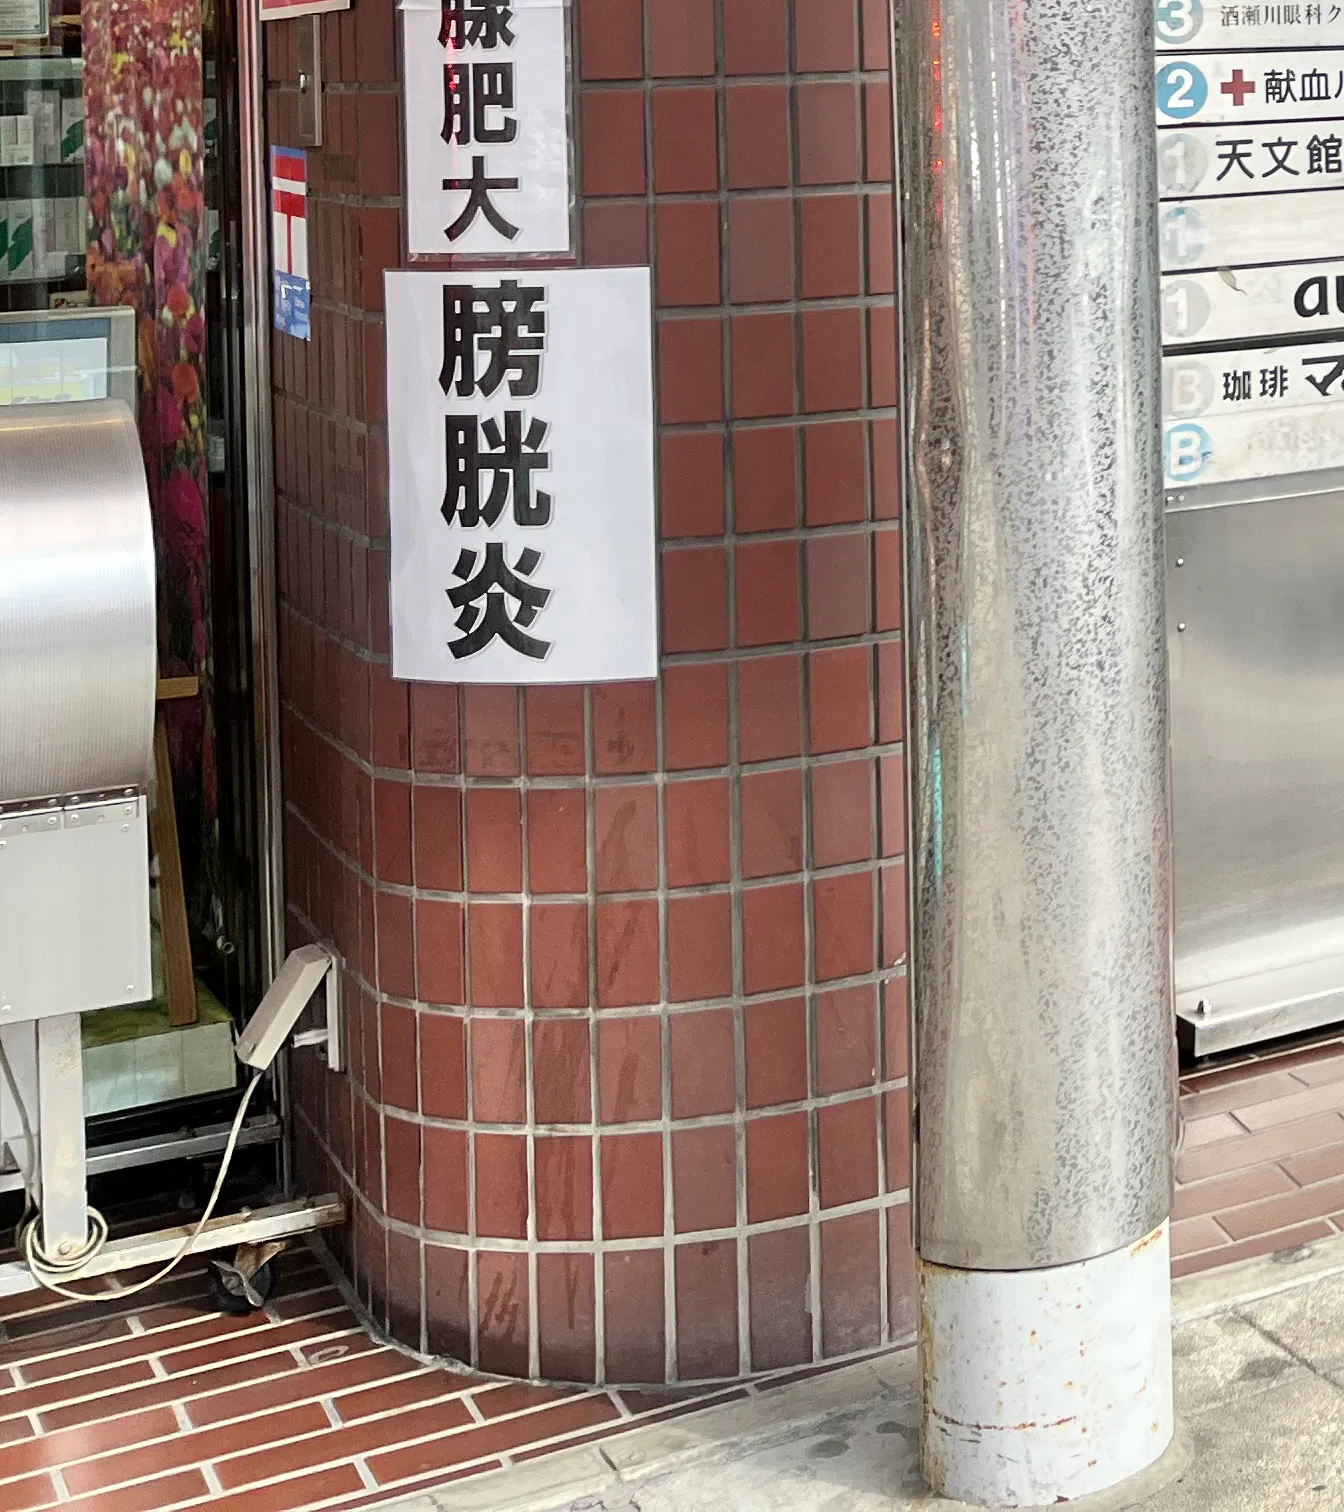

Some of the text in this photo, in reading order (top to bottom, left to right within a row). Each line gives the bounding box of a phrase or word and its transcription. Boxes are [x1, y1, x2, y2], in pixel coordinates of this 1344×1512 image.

[1167, 67, 1194, 109] 2
[1223, 365, 1288, 401] 珈琲
[438, 279, 554, 661] 膀胱炎
